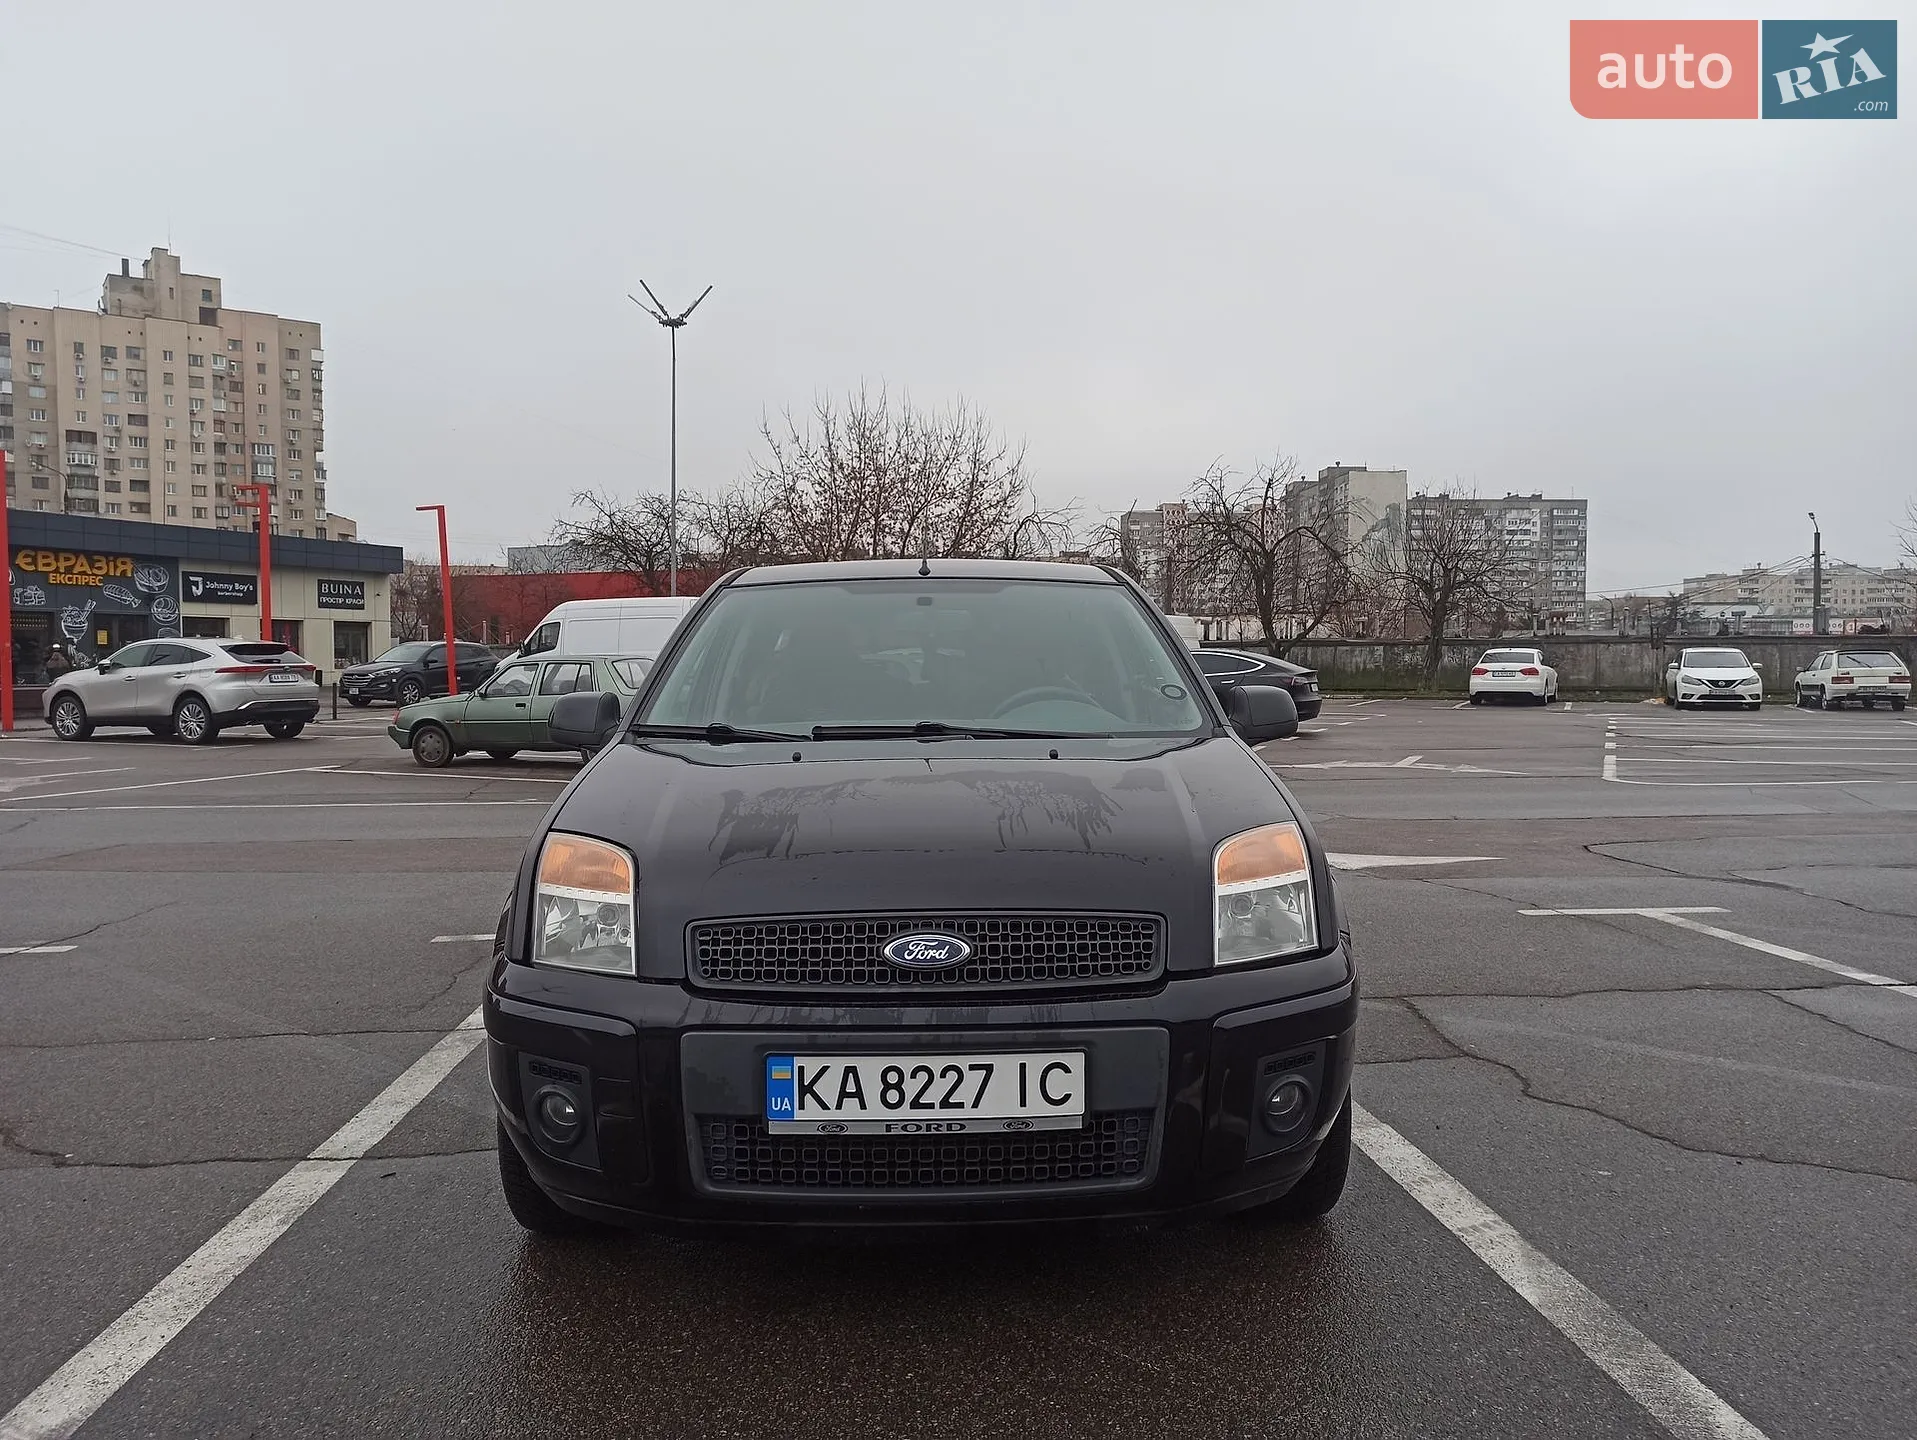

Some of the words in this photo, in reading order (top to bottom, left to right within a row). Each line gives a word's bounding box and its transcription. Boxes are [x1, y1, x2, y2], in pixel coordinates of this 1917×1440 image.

[48, 573, 104, 586] ЕКСПРЕС
[205, 581, 233, 591] Johnny
[234, 583, 254, 592] Boy's
[321, 583, 362, 595] BUINA
[904, 941, 950, 960] Ford
[797, 1064, 868, 1111] KA
[879, 1063, 994, 1110] 8227
[1018, 1061, 1072, 1107] IC
[771, 1097, 792, 1111] UA
[884, 1121, 967, 1133] FORD
